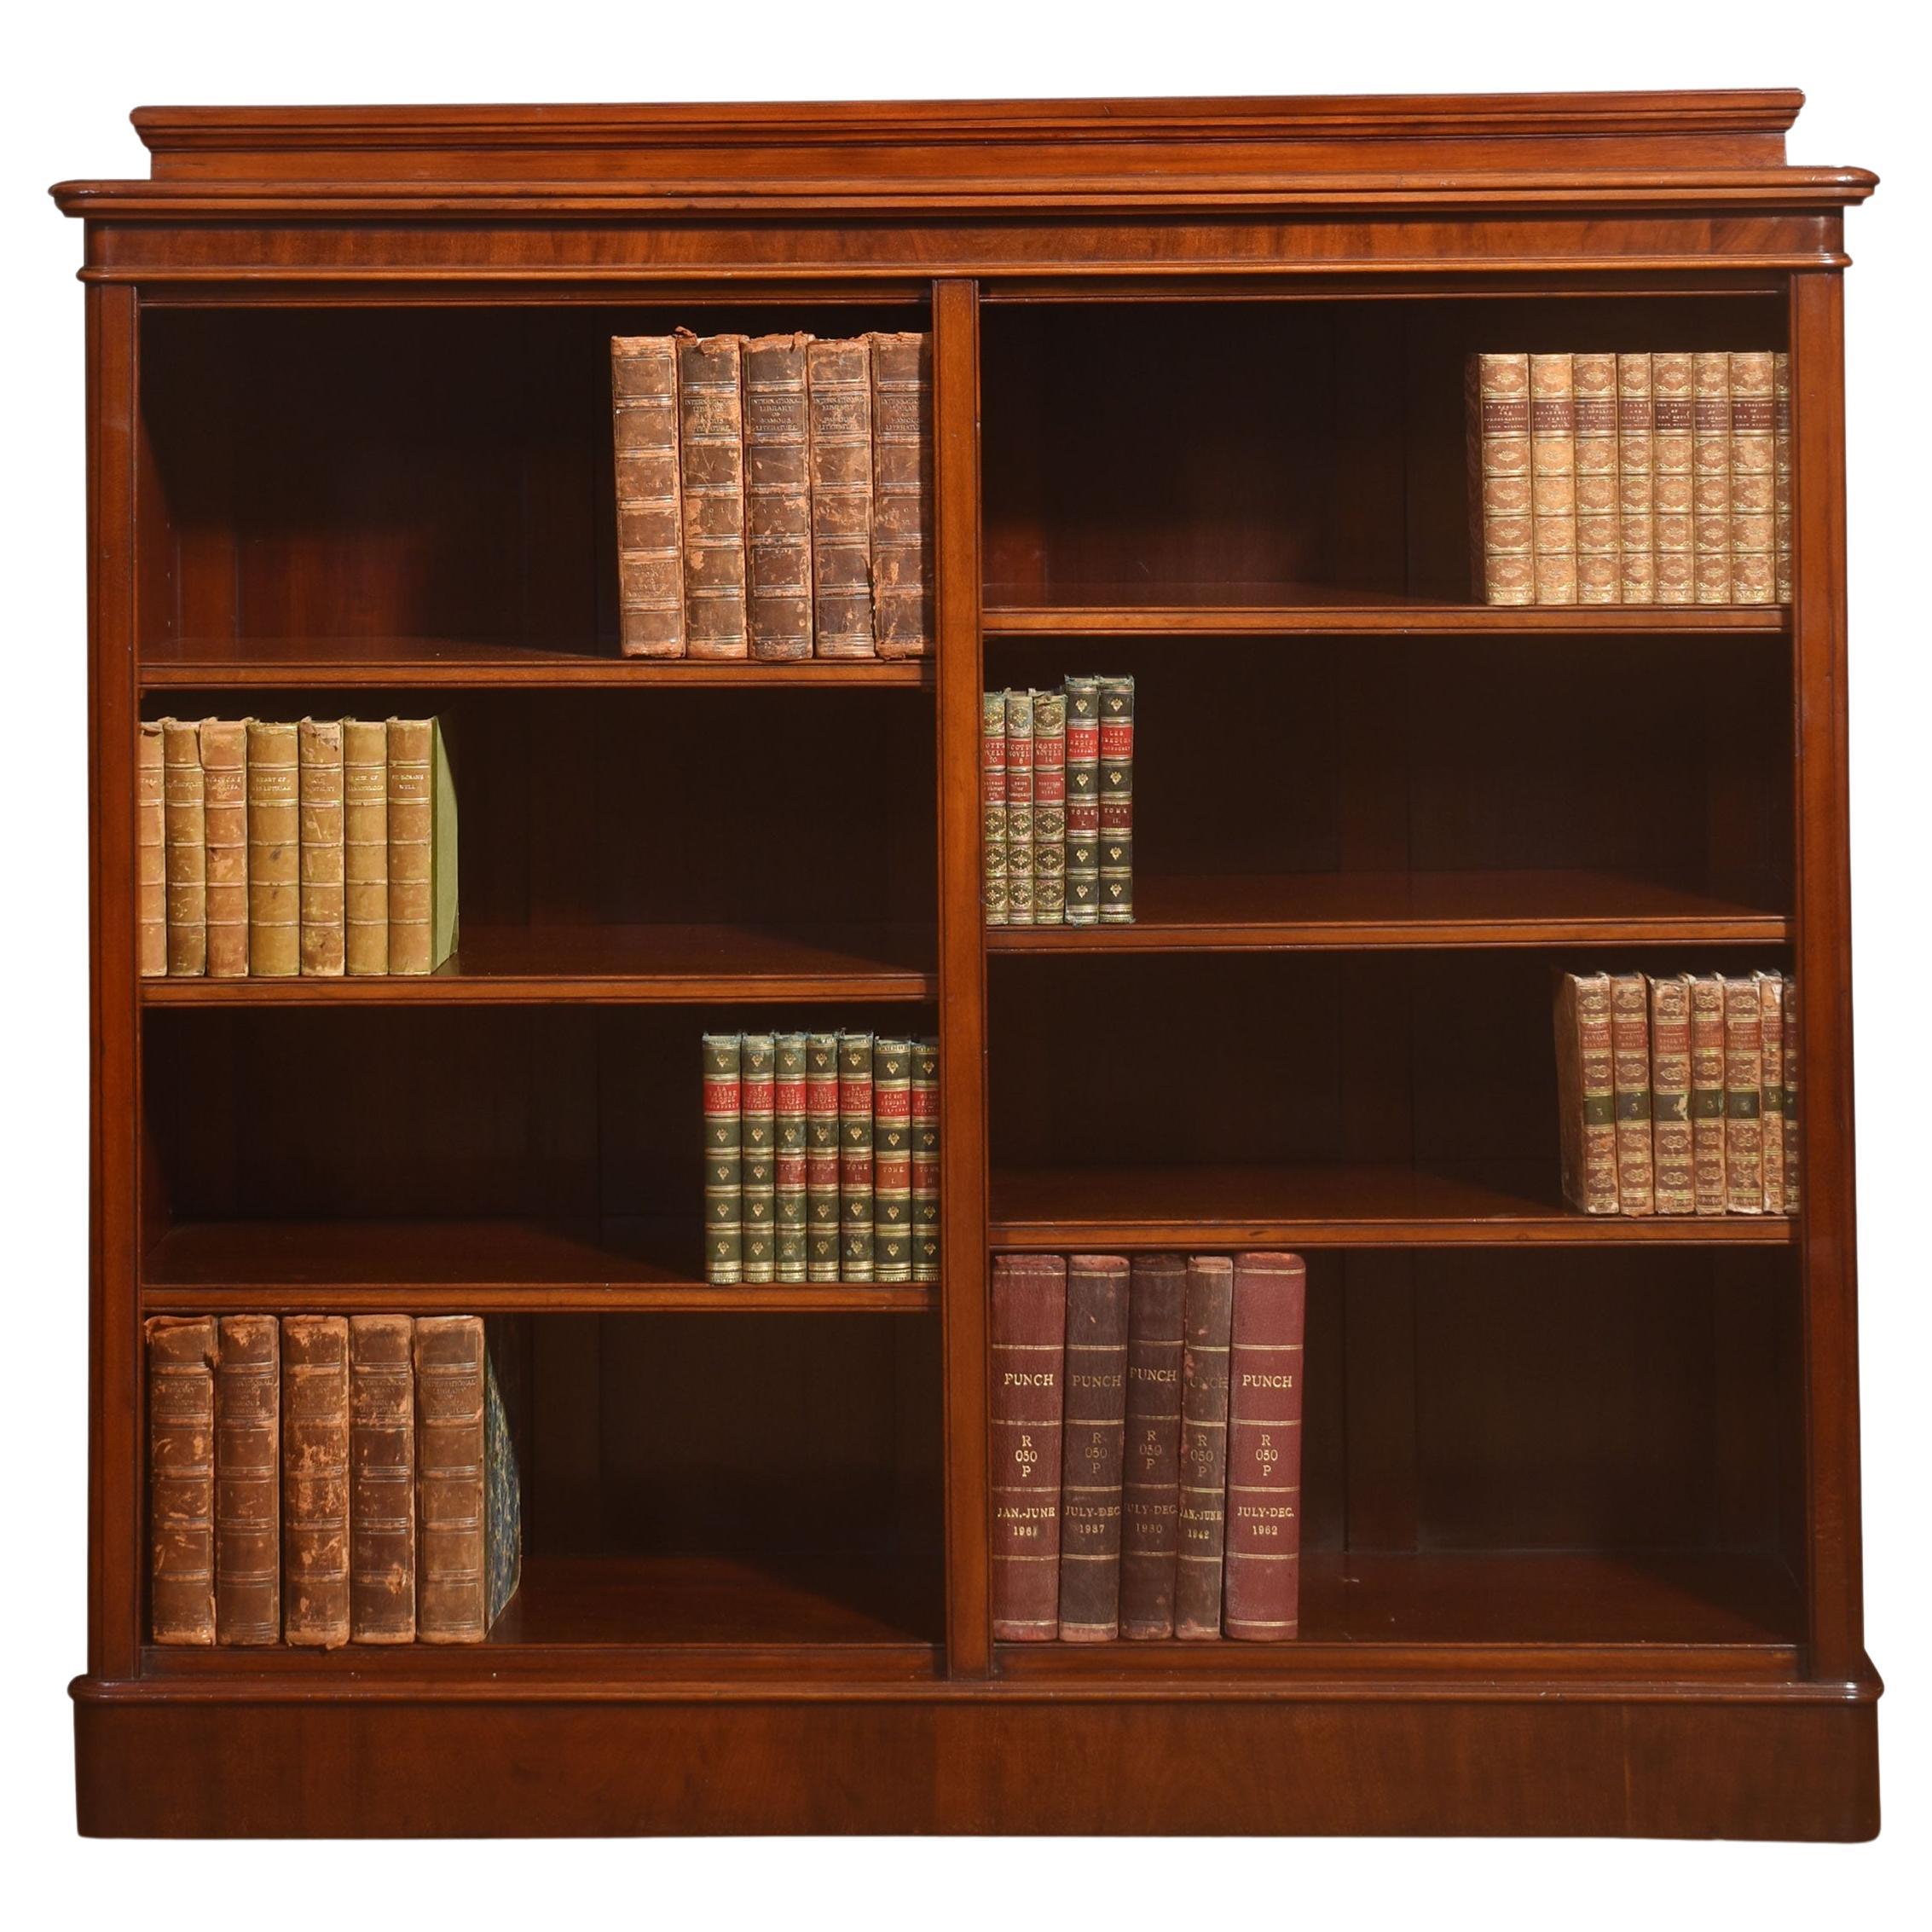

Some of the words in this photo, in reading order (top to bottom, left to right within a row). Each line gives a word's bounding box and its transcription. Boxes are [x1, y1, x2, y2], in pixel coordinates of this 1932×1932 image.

[1004, 1373, 1054, 1386] PUNCH
[1130, 1368, 1177, 1381] PUNCH
[1073, 1374, 1122, 1387] PUNCH
[1188, 1377, 1228, 1389] UNCH
[1242, 1374, 1293, 1388] PUNCH
[1022, 1435, 1032, 1447] R
[1092, 1432, 1102, 1443] R
[1147, 1431, 1156, 1441] R
[1198, 1435, 1207, 1446] R
[1262, 1434, 1270, 1446] R
[1015, 1450, 1038, 1462] 050
[1085, 1448, 1108, 1459] 050
[1190, 1450, 1213, 1462] 050
[1255, 1449, 1278, 1461] 050
[1092, 1463, 1101, 1473] P
[1146, 1459, 1155, 1470] P
[1022, 1466, 1031, 1477] P
[1198, 1466, 1207, 1478] P
[1263, 1465, 1271, 1476] P
[997, 1507, 1056, 1518] JAN.-JUNE
[1237, 1507, 1294, 1518] JULY-DEC.
[1252, 1525, 1277, 1535] 1962
